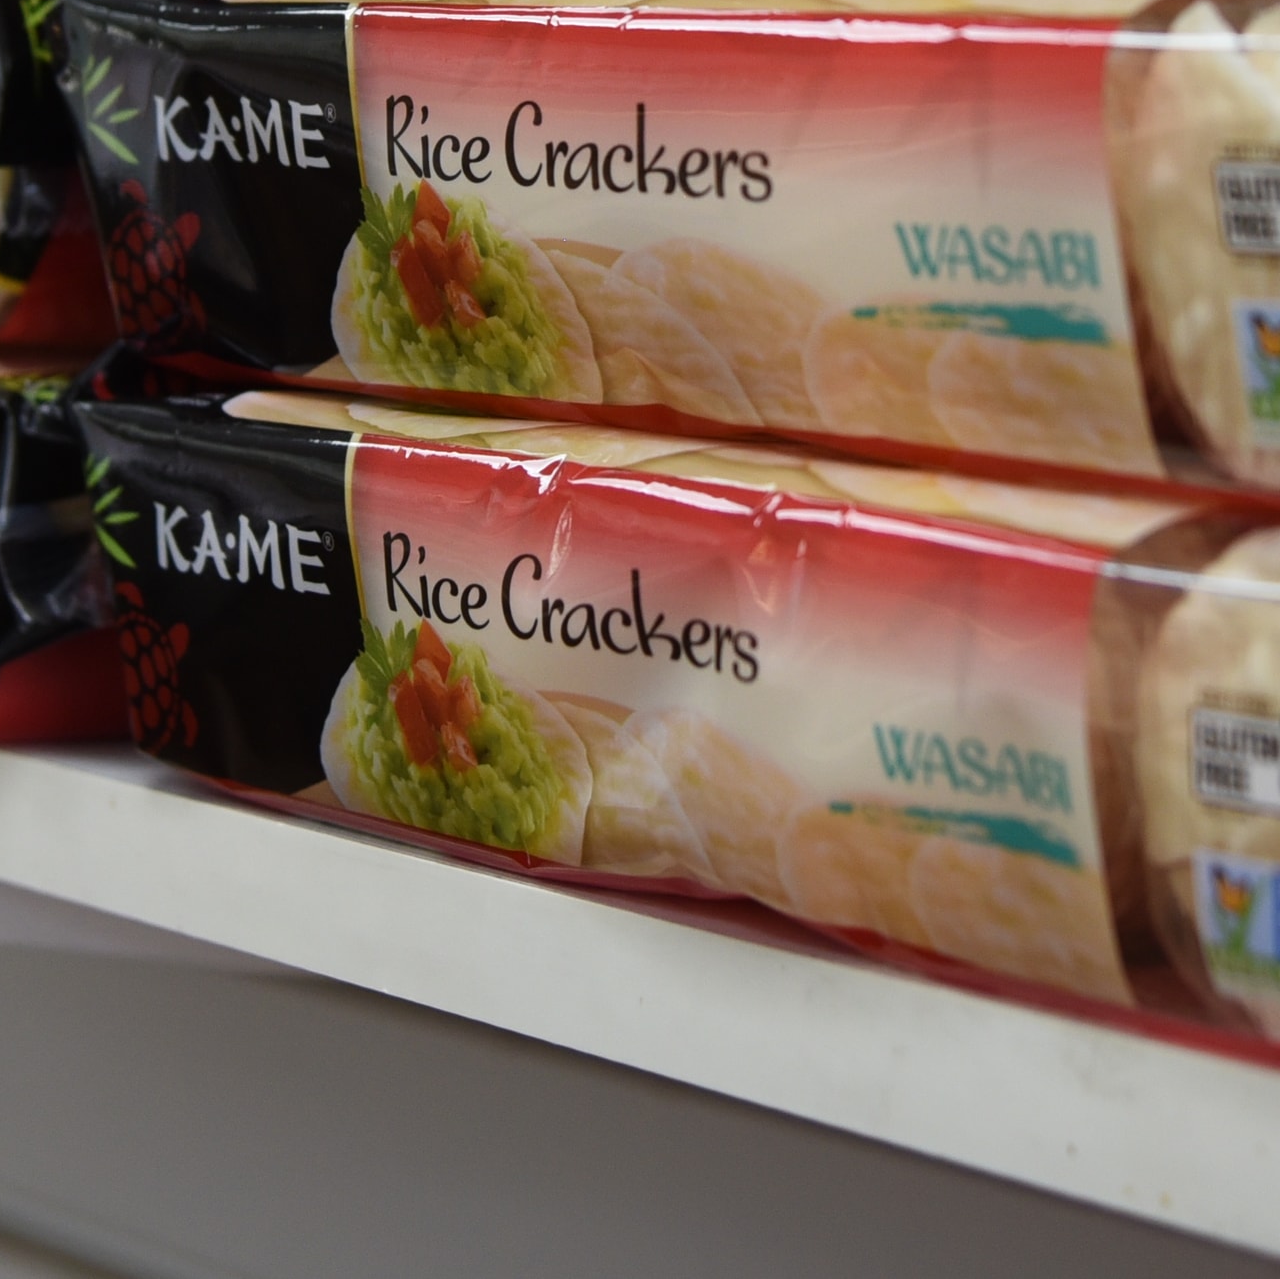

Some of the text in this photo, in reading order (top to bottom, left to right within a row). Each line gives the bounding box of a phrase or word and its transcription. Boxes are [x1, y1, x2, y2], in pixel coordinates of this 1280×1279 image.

[385, 94, 773, 203] Rice Crackers
[894, 221, 1103, 291] WASABI
[382, 531, 761, 684] Rice Crackers
[872, 721, 1076, 815] WASABI
